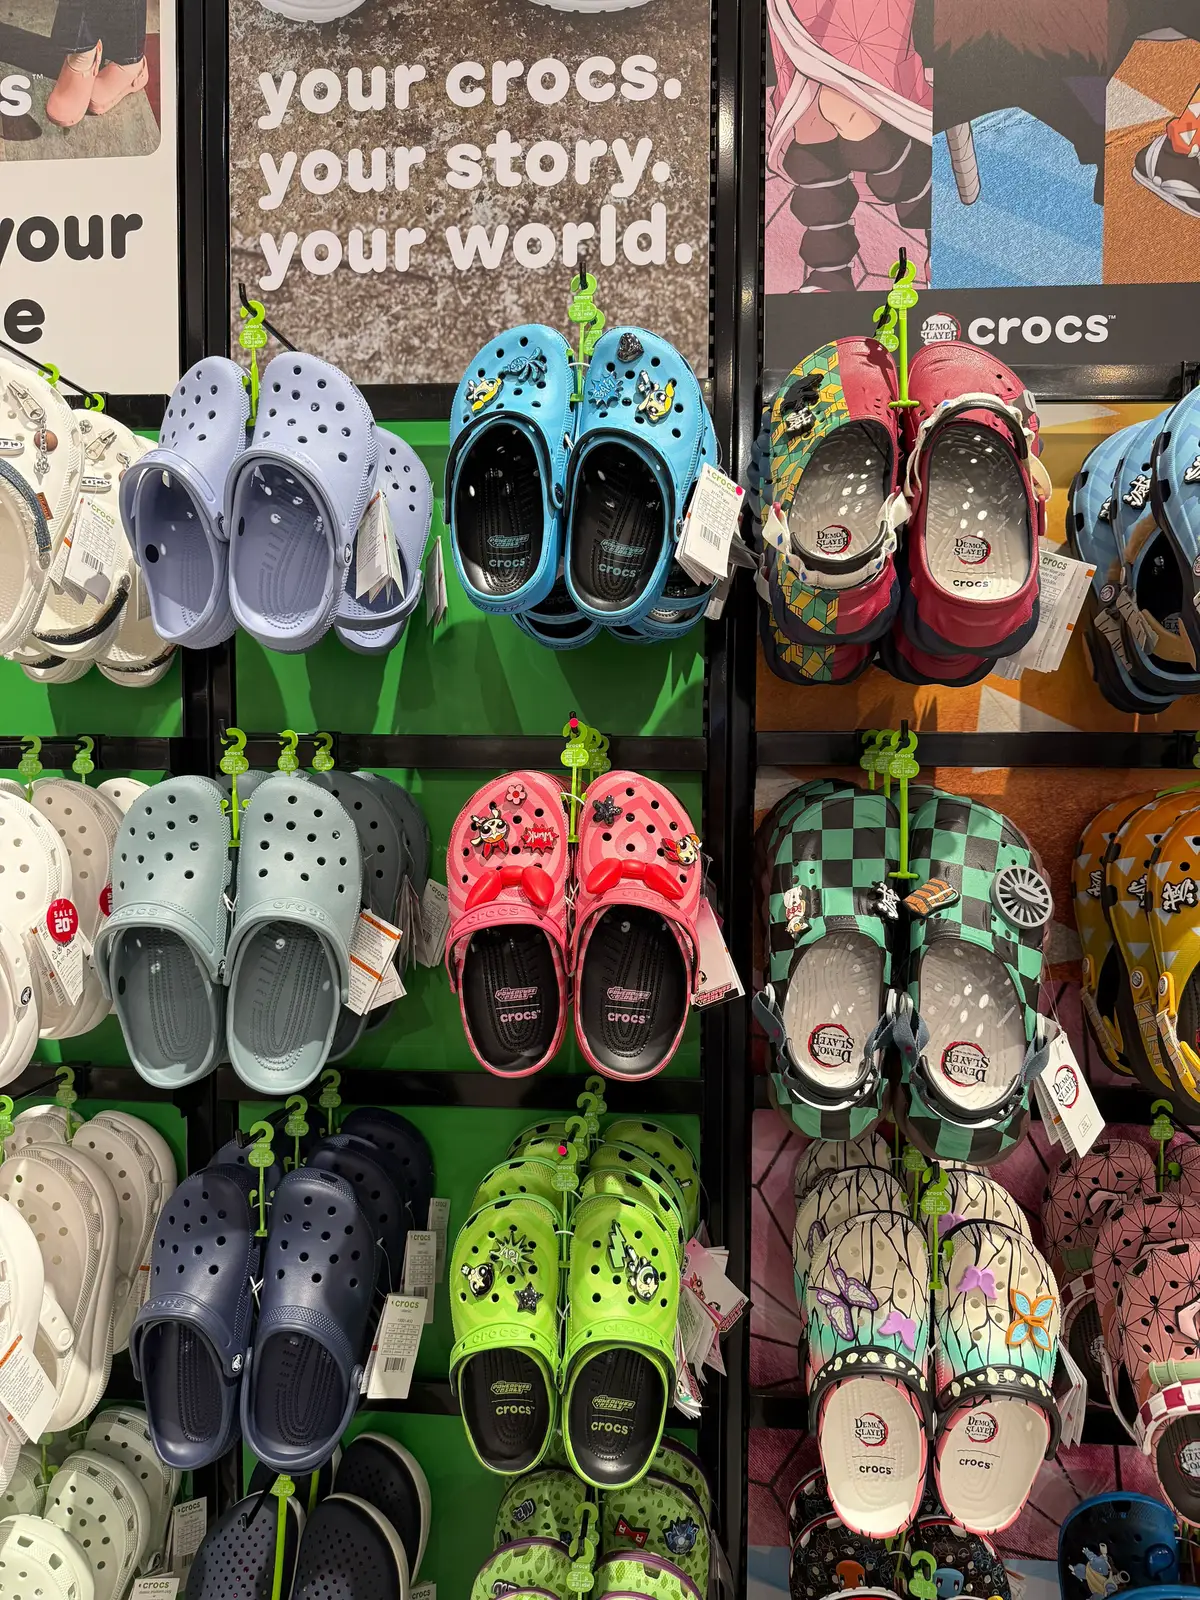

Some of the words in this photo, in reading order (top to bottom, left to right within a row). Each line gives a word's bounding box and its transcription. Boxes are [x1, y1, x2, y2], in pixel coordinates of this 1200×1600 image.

[258, 65, 426, 129] your
[445, 55, 681, 108] crocs.
[258, 146, 426, 210] your
[446, 129, 670, 198] story.
[258, 227, 427, 292] your
[445, 202, 693, 271] world.
[711, 471, 736, 493] crocs
[91, 503, 116, 525] crocs
[489, 558, 526, 568] crocs
[1042, 556, 1068, 570] crocs
[599, 563, 636, 578] crocs
[952, 579, 989, 588] crocs
[53, 908, 73, 919] SALE
[467, 907, 519, 924] crocs
[500, 1011, 538, 1023] crocs
[608, 1012, 646, 1024] crocs
[395, 1300, 420, 1309] crocs
[495, 1405, 532, 1416] crocs
[591, 1421, 629, 1435] crocs
[854, 1418, 884, 1429] DEMON
[967, 1416, 996, 1428] DEMON
[854, 1428, 886, 1439] SLAYER
[965, 1425, 996, 1436] SLAYER
[859, 1465, 892, 1475] crocs
[959, 1458, 991, 1470] crocs
[181, 1502, 200, 1513] crocs
